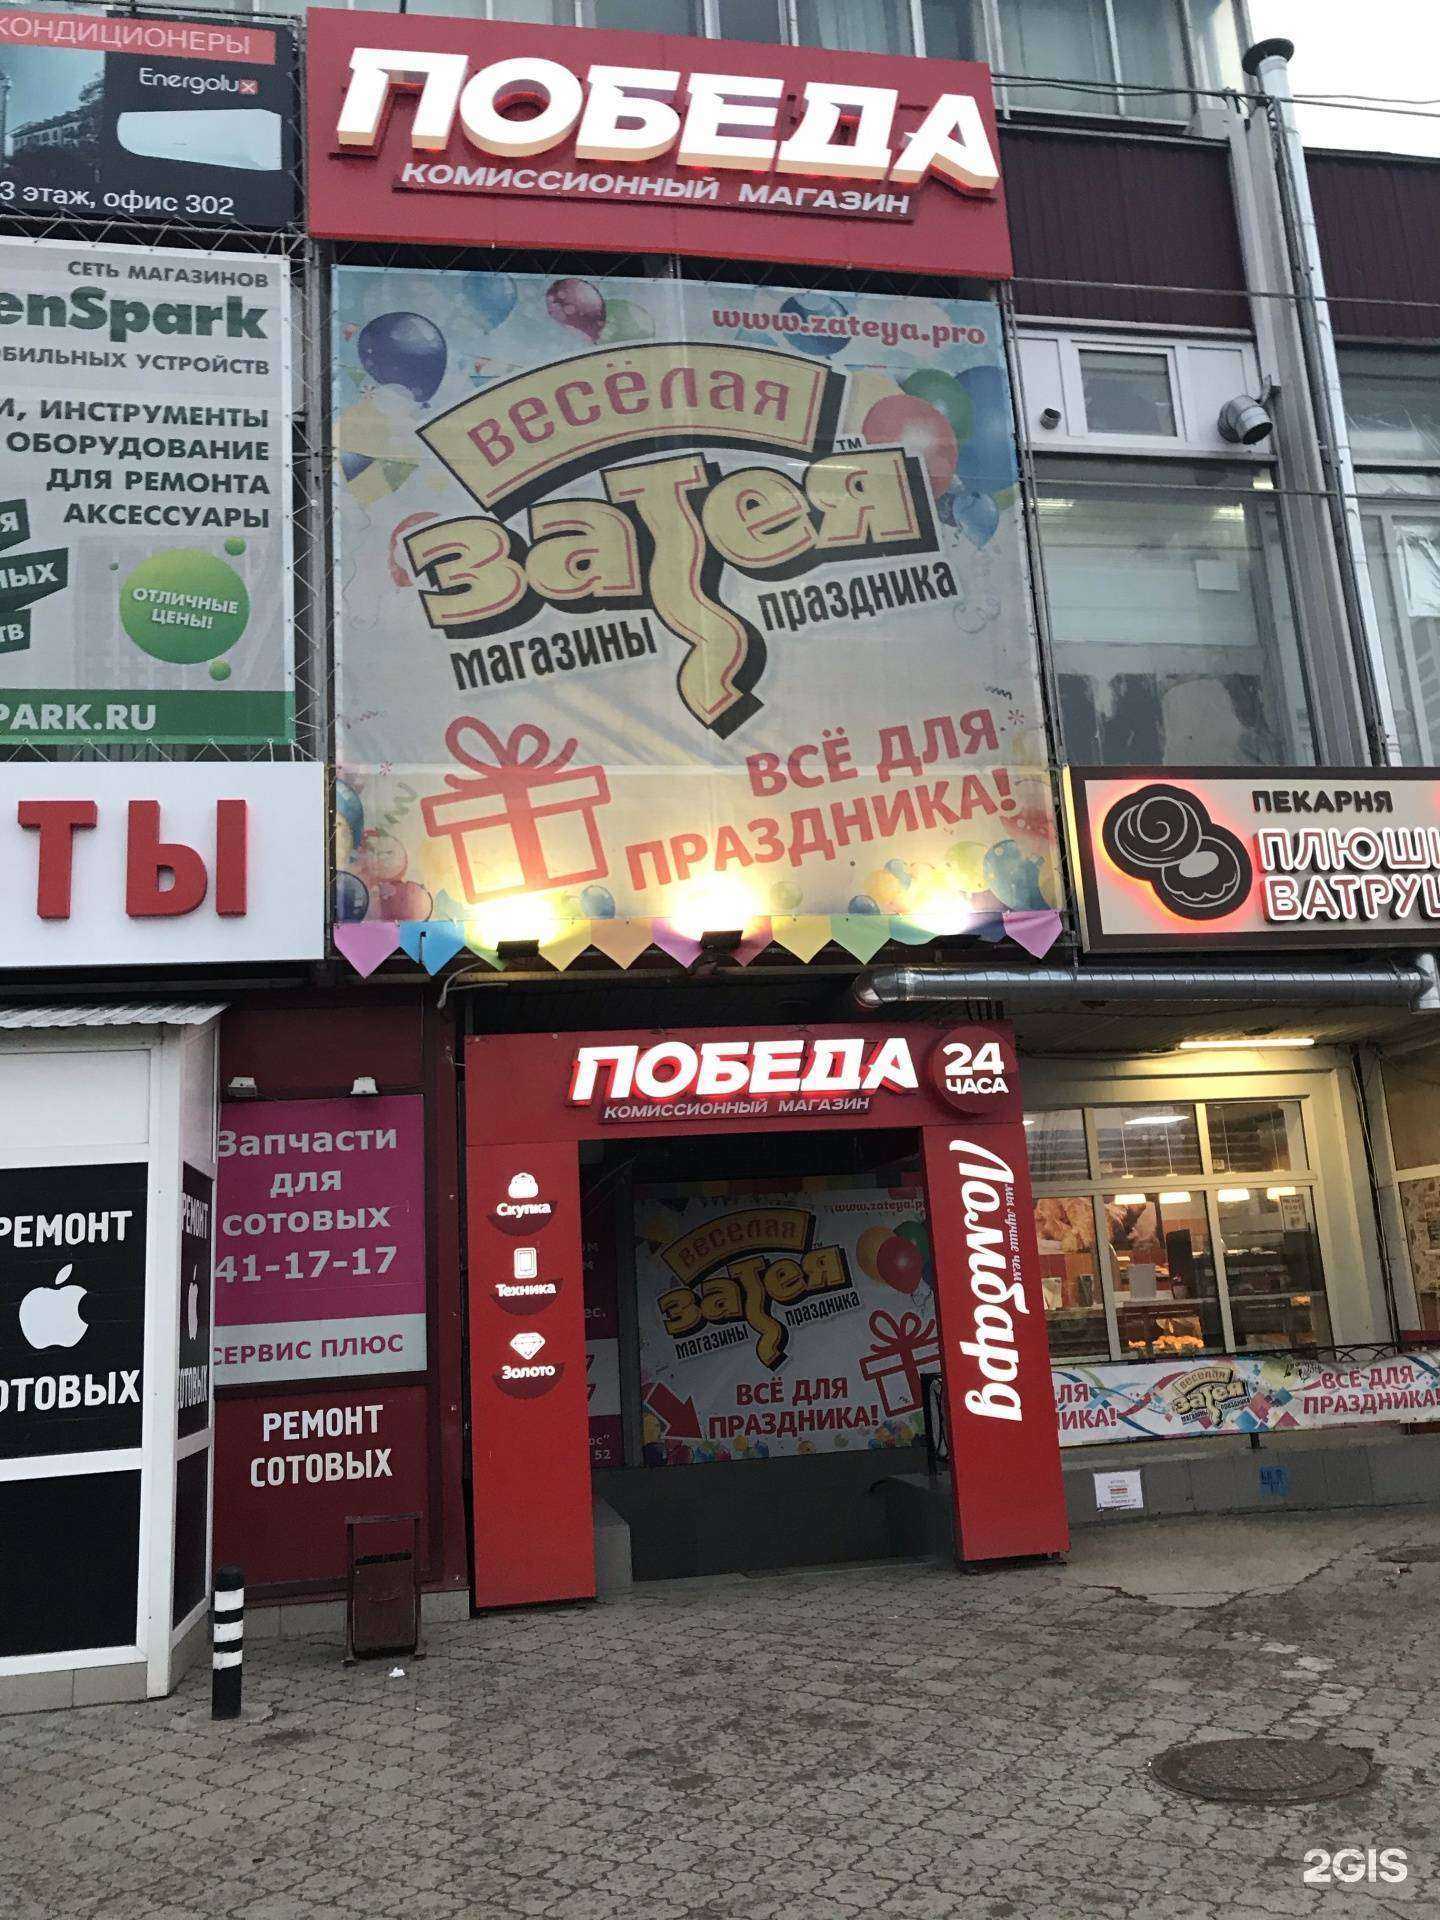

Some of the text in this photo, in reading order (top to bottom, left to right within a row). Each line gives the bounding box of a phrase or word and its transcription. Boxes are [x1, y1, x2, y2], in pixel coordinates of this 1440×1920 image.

[139, 67, 257, 94] Energolux
[336, 47, 1000, 191] ПОБЕДА
[0, 181, 235, 216] 3 этаж, офис 302
[401, 162, 911, 215] КОМИССИОННЫЙ МАГАЗИН
[68, 261, 269, 288] СЕТЬ МАГАЗИНОВ
[711, 306, 987, 347] www.zateya.pro
[137, 354, 270, 376] УСТРОЙСТВ
[41, 400, 269, 428] ИНСТРУМЕНТЫ
[6, 432, 270, 461] ОБОРУДОВАНИЕ
[46, 468, 270, 494] ДЛЯ РЕМОНТА
[63, 503, 270, 528] АКСЕССУАРЫ
[133, 587, 239, 616] ОТЛИЧНЫЕ
[151, 608, 214, 631] ЦЕНЫ!
[746, 708, 1001, 798] ВСЁ ДЛЯ
[1252, 790, 1394, 813] ПЕКАРНЯ
[624, 767, 1018, 892] ПРАЗДНИКА!
[18, 799, 248, 919] ТЫ
[571, 1037, 920, 1101] ПОБЕДА
[942, 1042, 1005, 1076] 24
[604, 1097, 870, 1119] КОМИССИОННЫЙ МАГАЗИН
[217, 1127, 397, 1158] Запчасти
[496, 1201, 551, 1218] Скупка
[215, 1246, 398, 1284] 41-17-17
[495, 1282, 556, 1298] Техника
[949, 1139, 1030, 1422] Ломбард
[321, 1334, 405, 1360] ПЛЮС
[501, 1365, 556, 1381] Золото
[1369, 1365, 1415, 1389] ДЛЯ
[736, 1377, 849, 1406] ВСЁ ДЛЯ
[1058, 1384, 1089, 1404] ЛЯ
[263, 1404, 384, 1442] РЕМОНТ
[708, 1405, 879, 1440] ПРАЗДНИКА!
[1058, 1407, 1118, 1430] ИКА!
[250, 1448, 394, 1488] СОТОВЫХ
